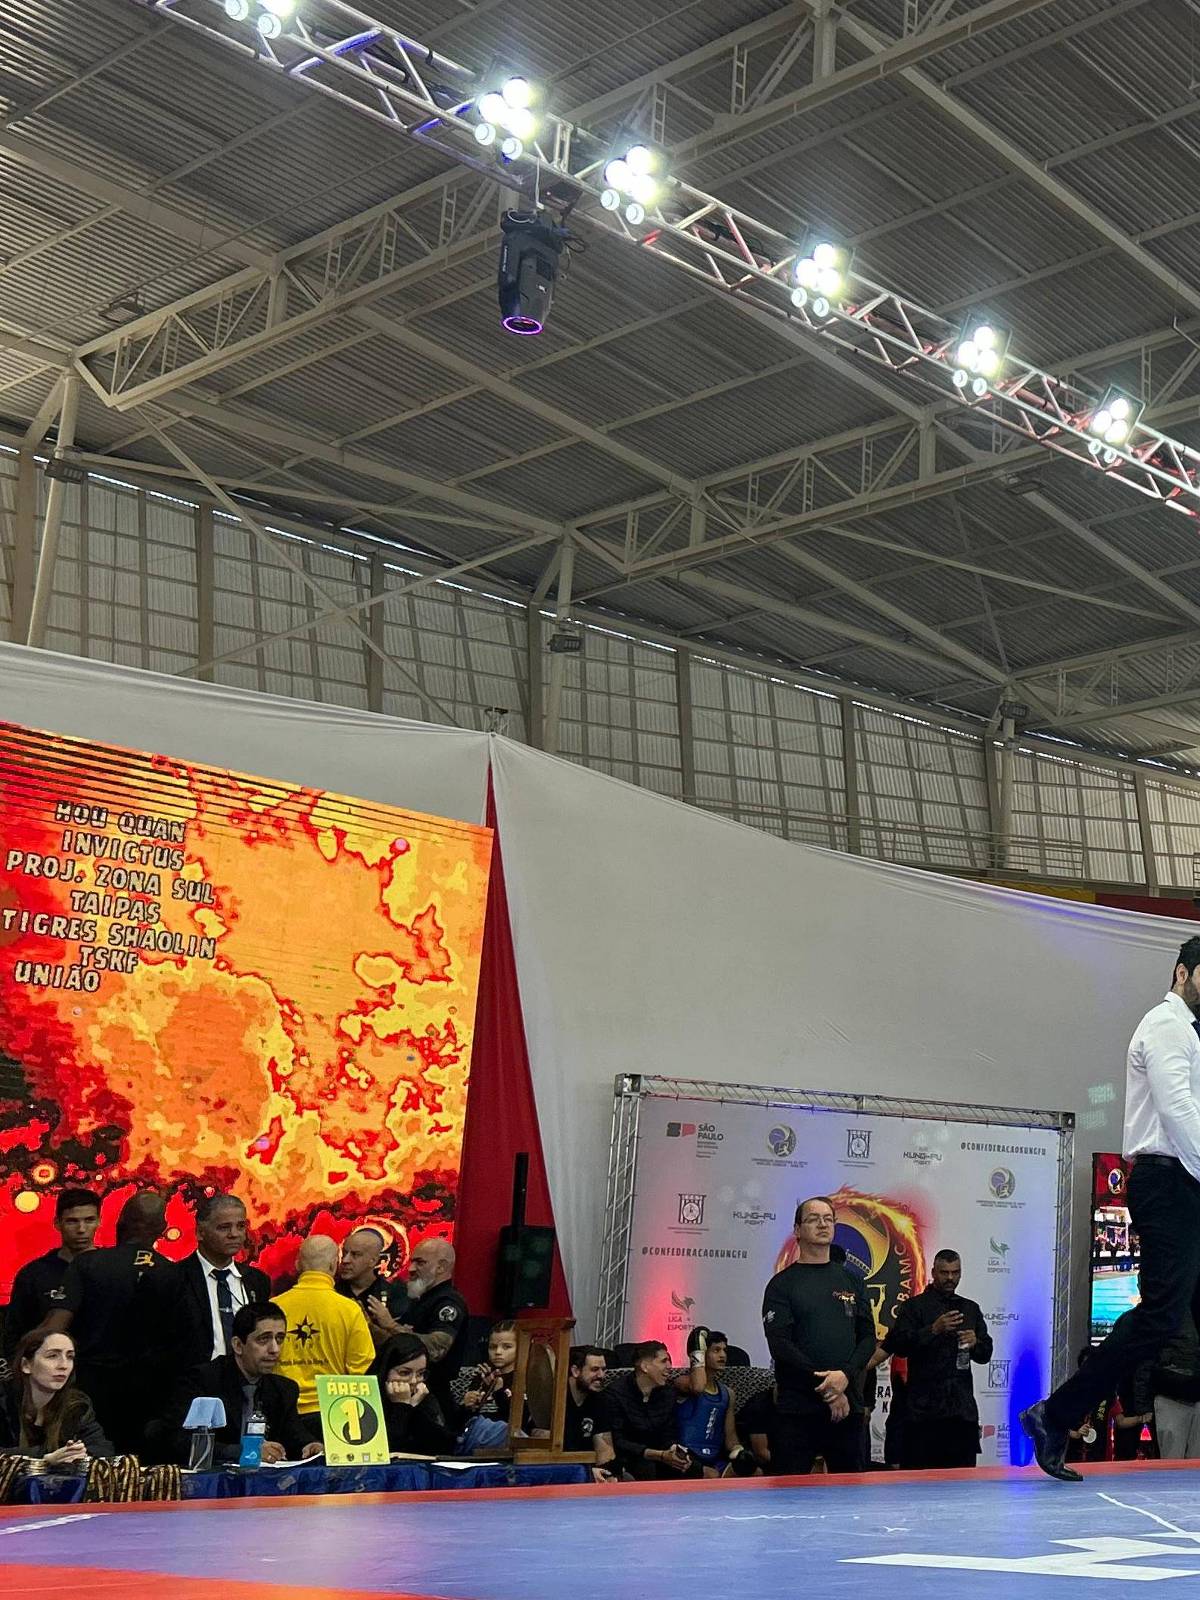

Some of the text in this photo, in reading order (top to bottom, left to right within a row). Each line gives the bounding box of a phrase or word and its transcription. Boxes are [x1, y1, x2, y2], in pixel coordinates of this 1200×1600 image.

[55, 801, 186, 843] HOU QUAN
[62, 829, 185, 871] INVICTUS
[5, 850, 215, 904] PROJ. ZONA SUL
[70, 890, 161, 924] TAIPAS
[2, 908, 216, 960] TIGRES SHAOLIN
[14, 960, 100, 993] UNIÃO
[79, 945, 139, 974] TSKF
[697, 1132, 724, 1141] PAULO
[698, 1122, 716, 1132] SÃO
[326, 1378, 371, 1396] ÁREA
[340, 1399, 362, 1441] 1
